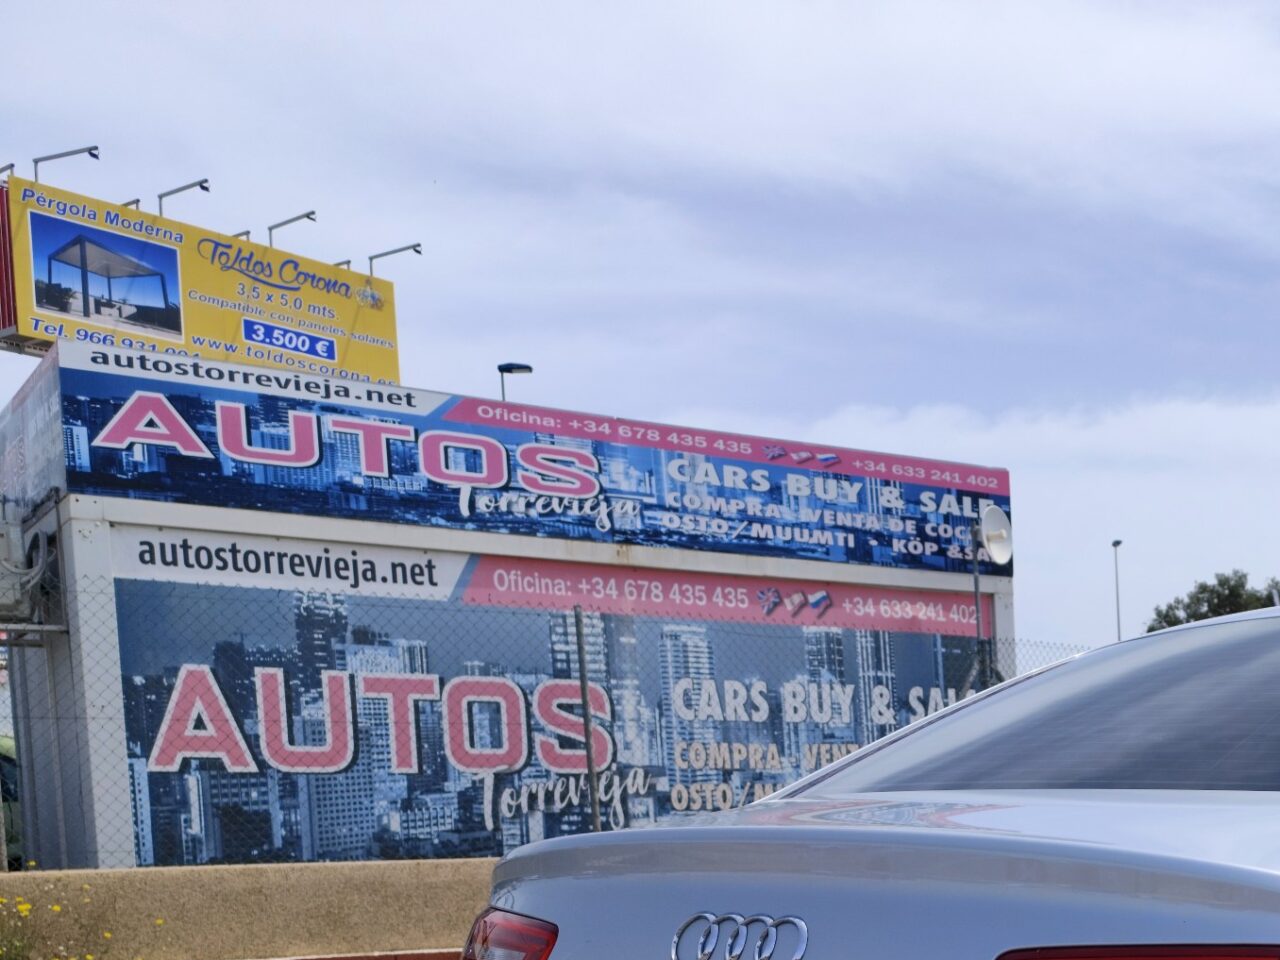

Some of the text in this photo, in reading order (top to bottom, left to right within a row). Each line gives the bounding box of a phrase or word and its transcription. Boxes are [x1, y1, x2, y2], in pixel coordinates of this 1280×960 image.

[22, 188, 184, 244] Pérgola Moderna
[197, 238, 352, 299] Toldos Corona
[188, 289, 394, 349] Compatible con paneles solares
[236, 282, 340, 321] 3,5 x 5,0 mts.
[29, 317, 68, 338] Tel.
[76, 328, 115, 347] 966
[251, 324, 330, 357] 3.500 €
[90, 350, 417, 408] autostorrevieja.net
[91, 390, 601, 498] AUTOS
[477, 405, 752, 455] Oficina: +34 678 435 435
[667, 458, 771, 492] CARS
[787, 473, 863, 504] BUY
[880, 486, 905, 509] &
[852, 459, 998, 488] +34 633 241 402
[452, 483, 641, 532] Torrevieja
[667, 492, 782, 518] COMPRA
[803, 508, 880, 531] VENTA
[889, 517, 917, 535] DE
[138, 538, 439, 588] autostorrevieja.net
[892, 536, 939, 556] KÖP
[493, 569, 749, 609] Oficina: +34 678 435 435
[842, 597, 977, 624] +34 633 241 402
[147, 663, 613, 774] AUTOS
[672, 677, 770, 723] CARS
[782, 682, 855, 724] BUY
[870, 685, 897, 725] &
[674, 740, 784, 771] COMPRA
[472, 764, 652, 831] Torreveja
